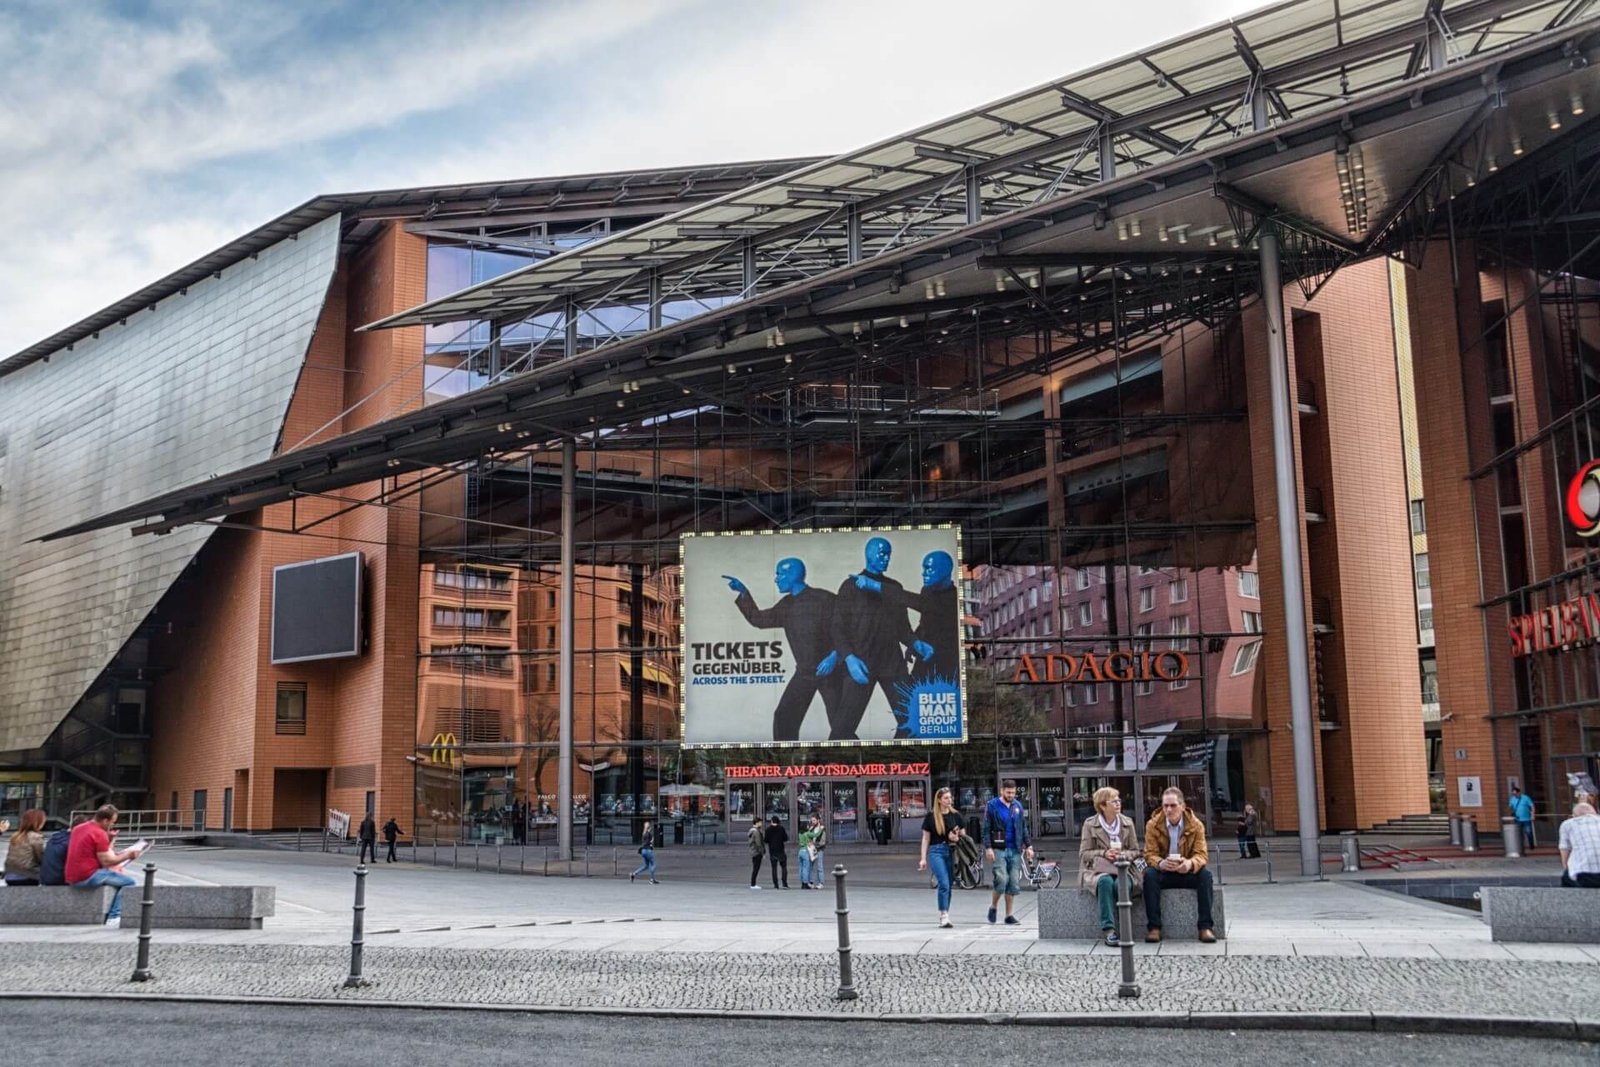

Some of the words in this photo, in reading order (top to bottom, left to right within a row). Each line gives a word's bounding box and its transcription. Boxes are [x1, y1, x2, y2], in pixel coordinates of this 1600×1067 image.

[691, 641, 783, 660] TICKETS
[692, 660, 786, 675] GEGENÜBER.
[1013, 651, 1189, 683] ADAGIO
[692, 677, 728, 685] ACROSS
[730, 676, 748, 684] THE
[750, 675, 785, 683] STREET.
[919, 693, 956, 704] BLUE
[919, 704, 957, 716] MAN
[919, 716, 957, 725] GROUP
[920, 725, 956, 734] BERLIN
[725, 765, 782, 777] THEATER
[785, 764, 807, 776] AM
[808, 763, 887, 776] POTSDAMER
[890, 762, 929, 775] PLATZ
